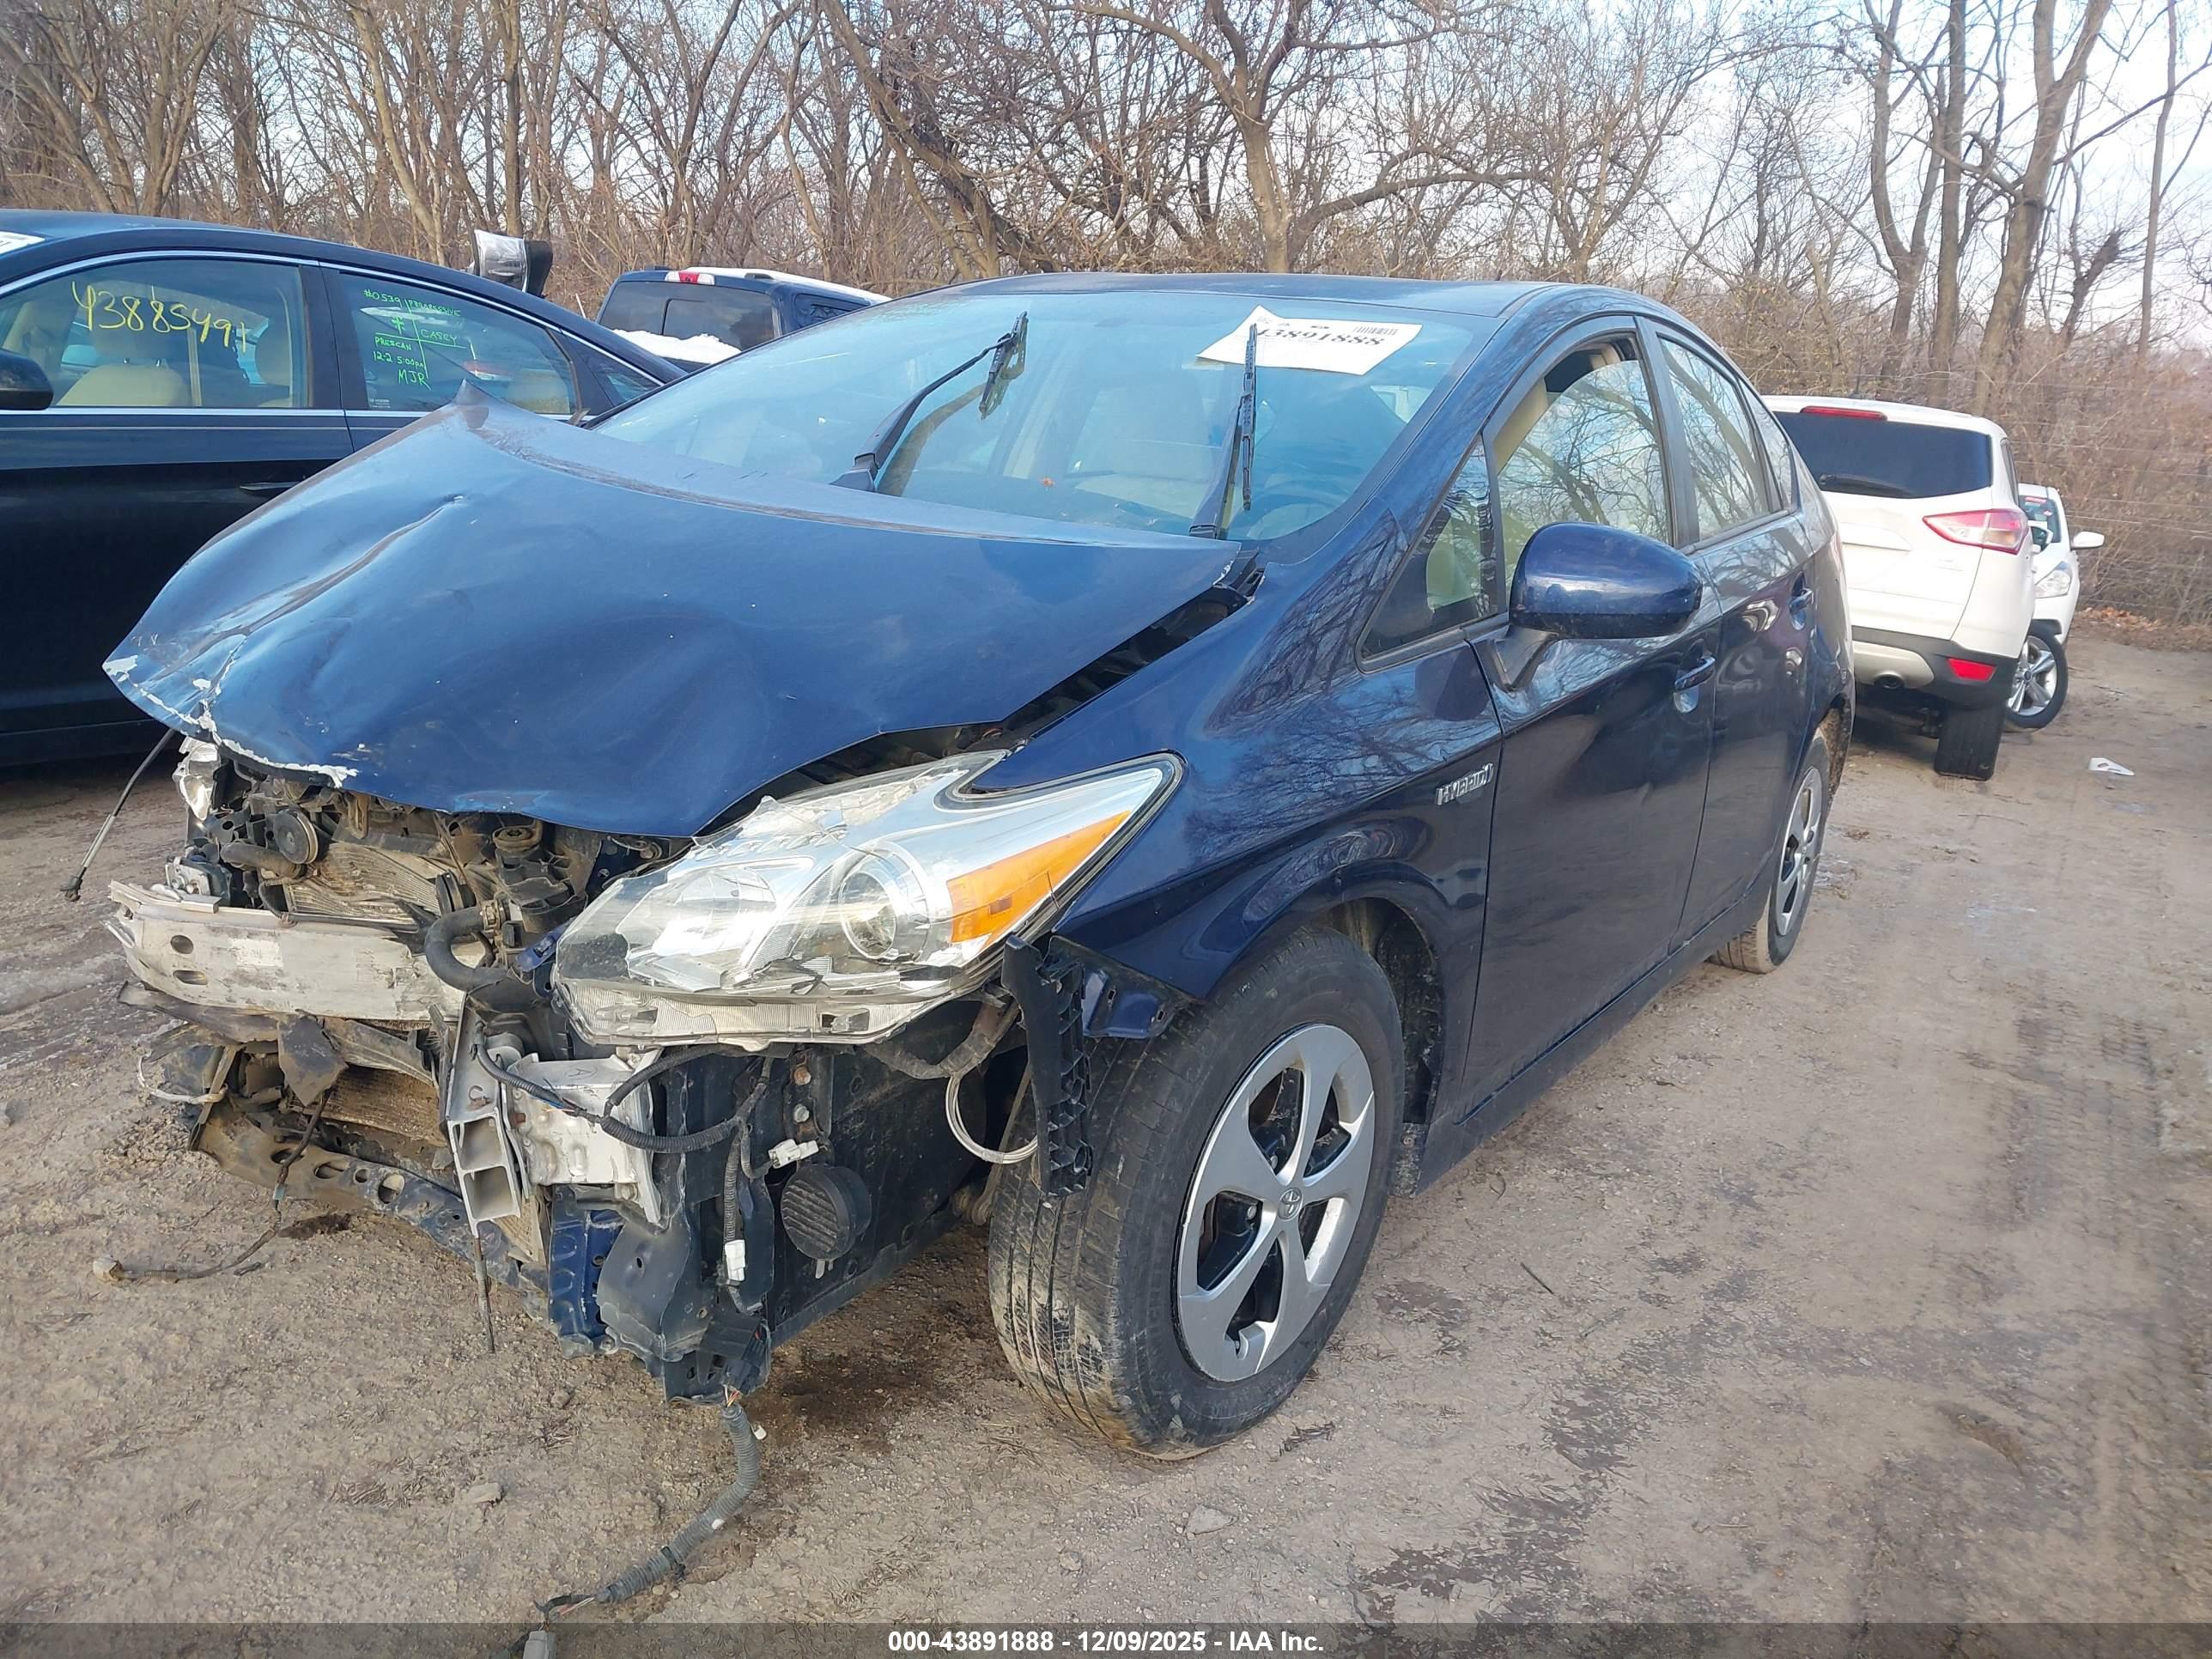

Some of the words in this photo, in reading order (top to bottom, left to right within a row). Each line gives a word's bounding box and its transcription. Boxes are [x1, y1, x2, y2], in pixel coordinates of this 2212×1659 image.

[72, 281, 246, 353] 43885491
[374, 336, 412, 350] PRESCAN
[421, 329, 457, 346] CASEY
[1435, 763, 1494, 805] HYBRID
